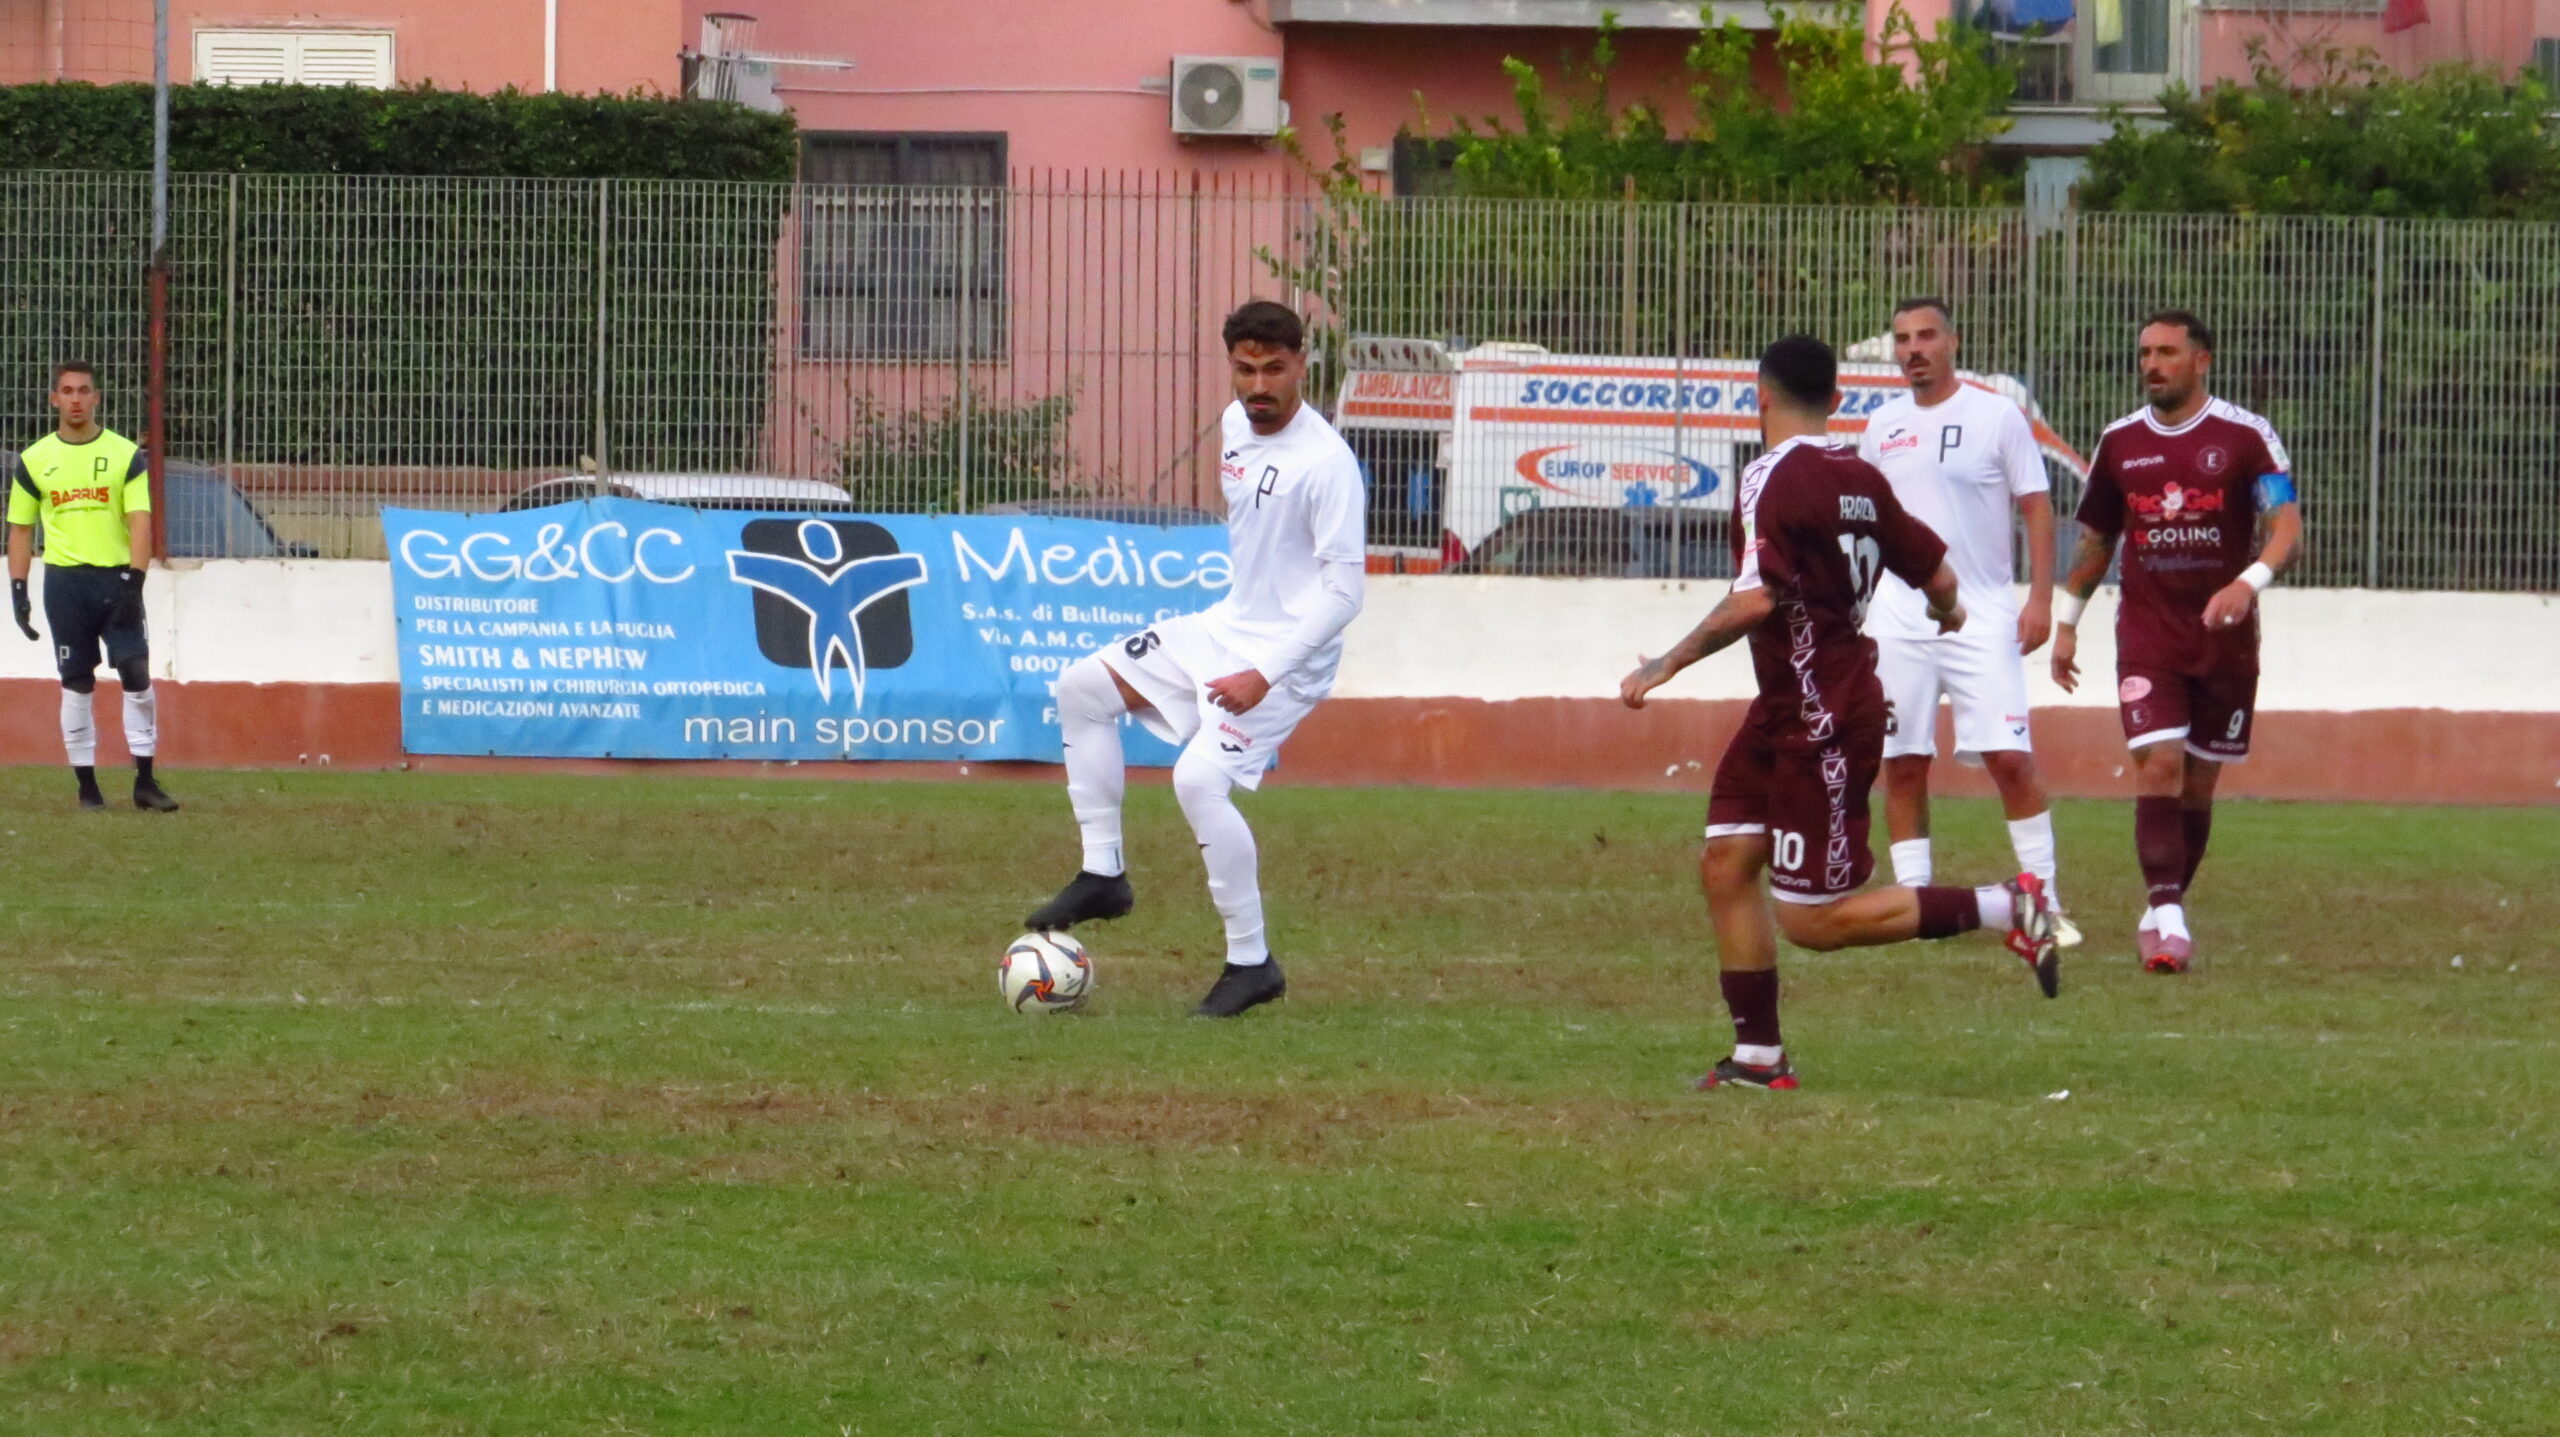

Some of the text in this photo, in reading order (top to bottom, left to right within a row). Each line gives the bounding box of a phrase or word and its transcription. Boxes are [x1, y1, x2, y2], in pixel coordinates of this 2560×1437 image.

[1353, 372, 1451, 400] AMBULANZA
[1520, 379, 1720, 410] SOCCORSO
[1544, 460, 1690, 483] EUROP SERVICE
[50, 486, 109, 507] BARRUS
[400, 521, 695, 584] GG&CC
[951, 527, 1234, 589] Medica
[414, 595, 539, 614] DISTRIBUTORE
[1031, 603, 1053, 621] di
[416, 618, 676, 639] PER LA CAMPANIA E LA PUGLIA
[419, 644, 648, 670] SMITH & NEPHEW
[1010, 655, 1082, 673] 8007
[422, 676, 766, 696] SPECIALISTI IN CHIRURGIA ORTOPEDICA
[422, 699, 641, 719] E MEDICAZIONI AVANZATE
[684, 710, 1005, 752] main sponsor
[2226, 709, 2244, 739] 9
[1772, 828, 1805, 871] 10
